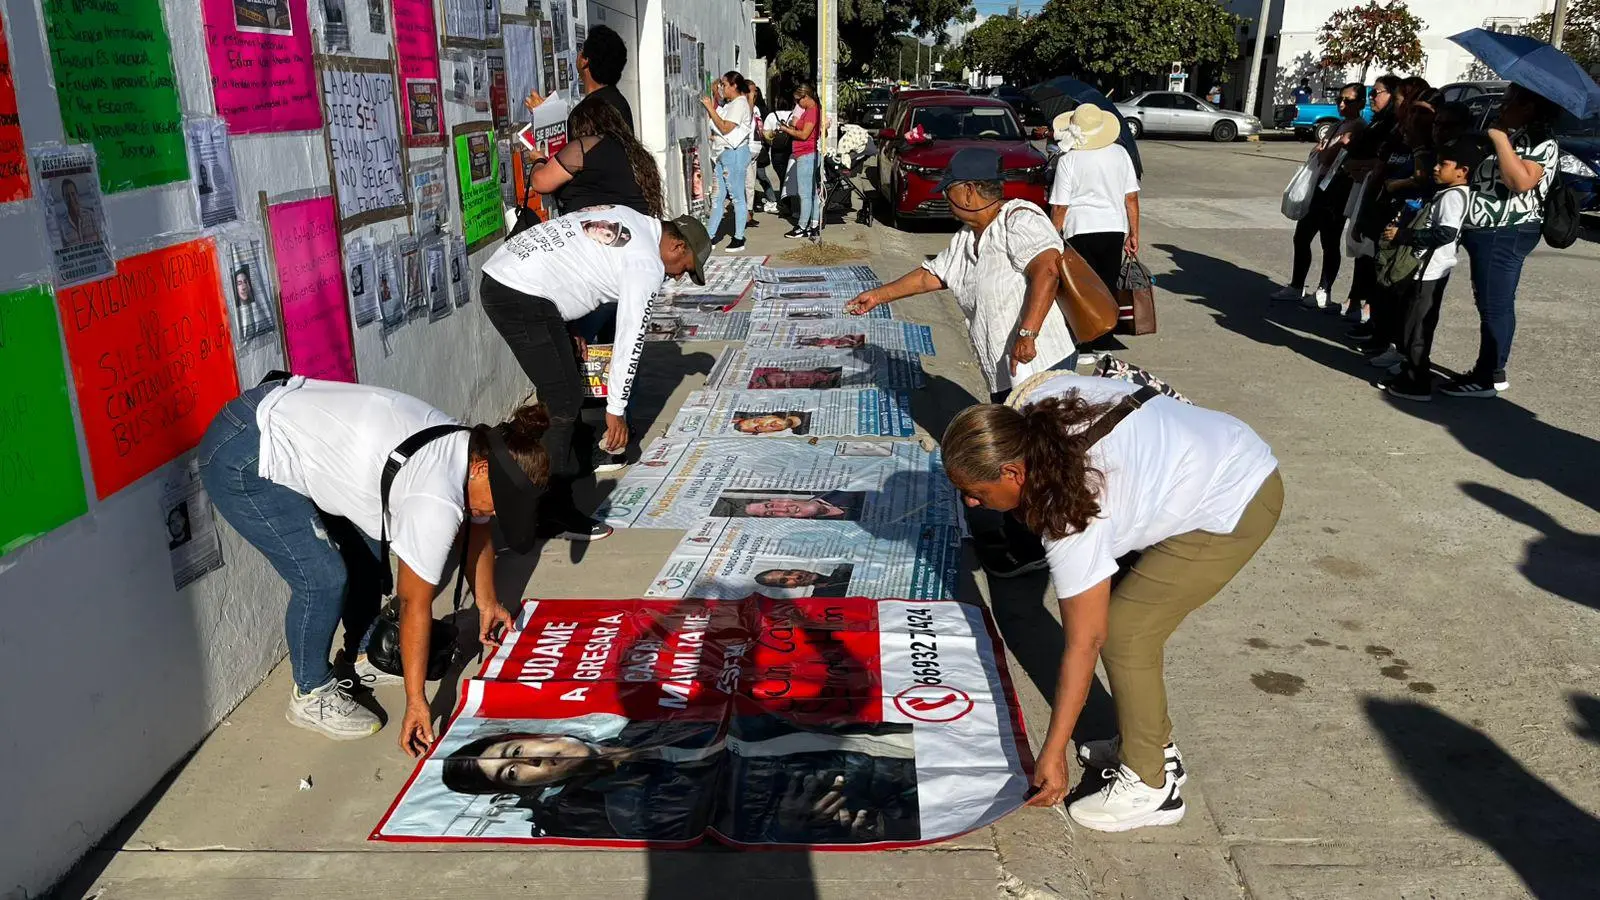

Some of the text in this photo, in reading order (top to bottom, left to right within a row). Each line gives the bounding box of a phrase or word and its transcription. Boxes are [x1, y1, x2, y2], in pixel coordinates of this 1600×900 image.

[326, 103, 354, 128] DEBE
[356, 103, 378, 130] SER
[536, 123, 565, 140] SE BUSCA
[341, 167, 357, 187] NO
[71, 267, 157, 332] EXIGIMOS
[160, 250, 208, 291] VERDAD
[99, 315, 192, 390] SILENCIO
[621, 378, 633, 400] NOS
[628, 333, 645, 375] FALTAN
[598, 613, 624, 625] A
[911, 640, 942, 686] 66932
